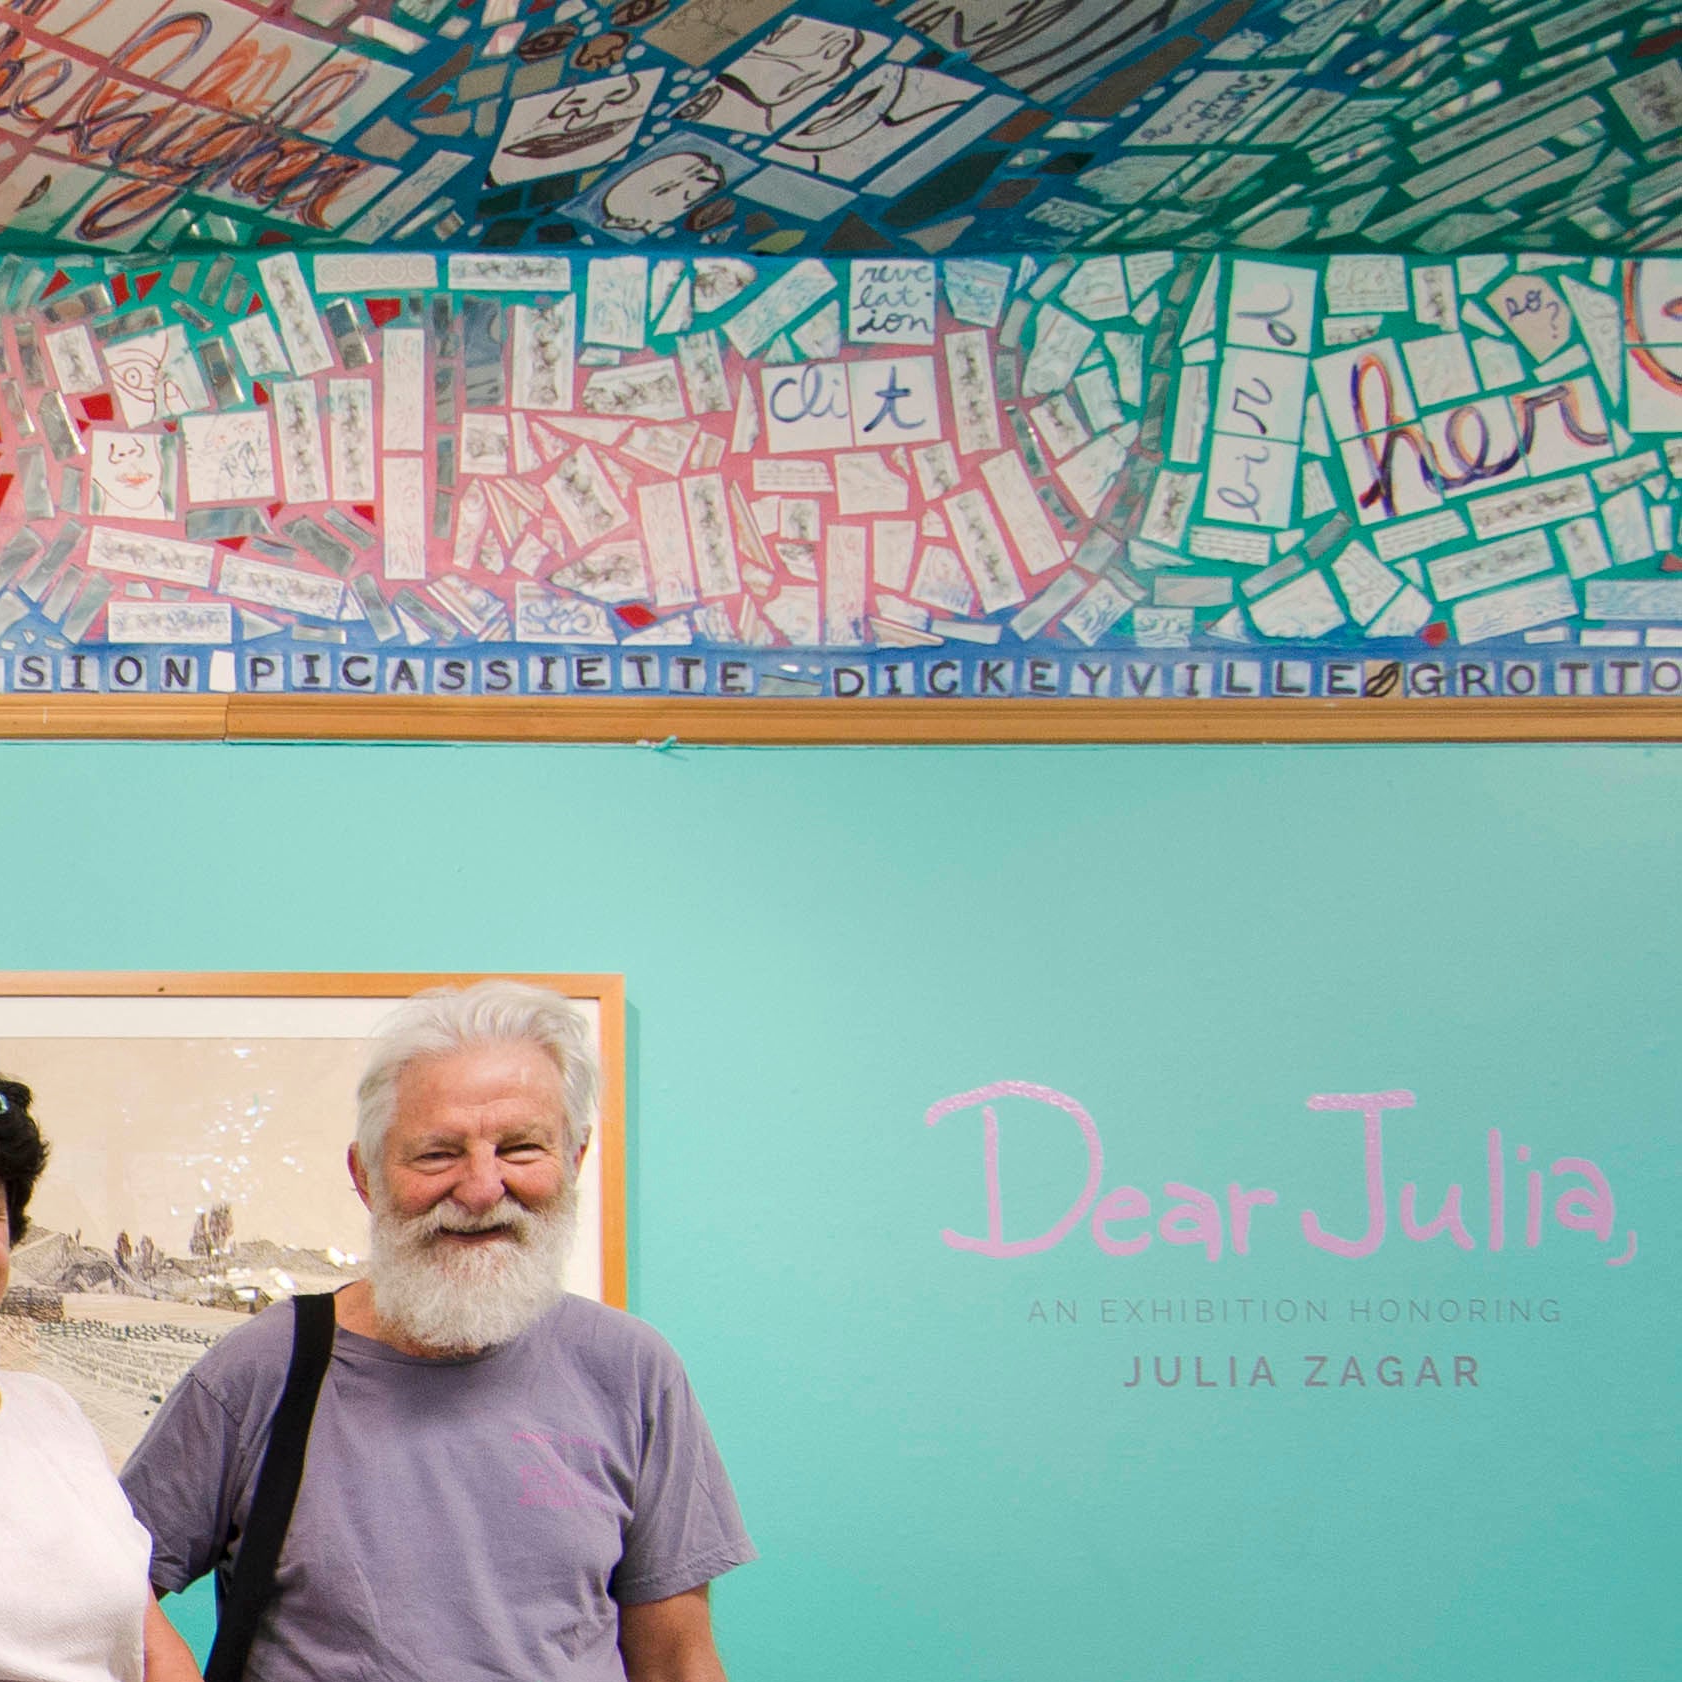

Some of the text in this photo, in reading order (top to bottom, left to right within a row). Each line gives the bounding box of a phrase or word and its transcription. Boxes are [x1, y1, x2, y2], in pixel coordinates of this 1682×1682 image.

[1350, 351, 1610, 519] her
[249, 653, 748, 692] PICASSIETTE
[834, 660, 1361, 697] DICKEYVILLE
[1410, 660, 1682, 697] GROTTO
[925, 1079, 1637, 1267] Dear Julia,
[1028, 1299, 1563, 1324] AN EXHIBITION HONORING
[1123, 1355, 1481, 1388] JULIA ZAGAR
